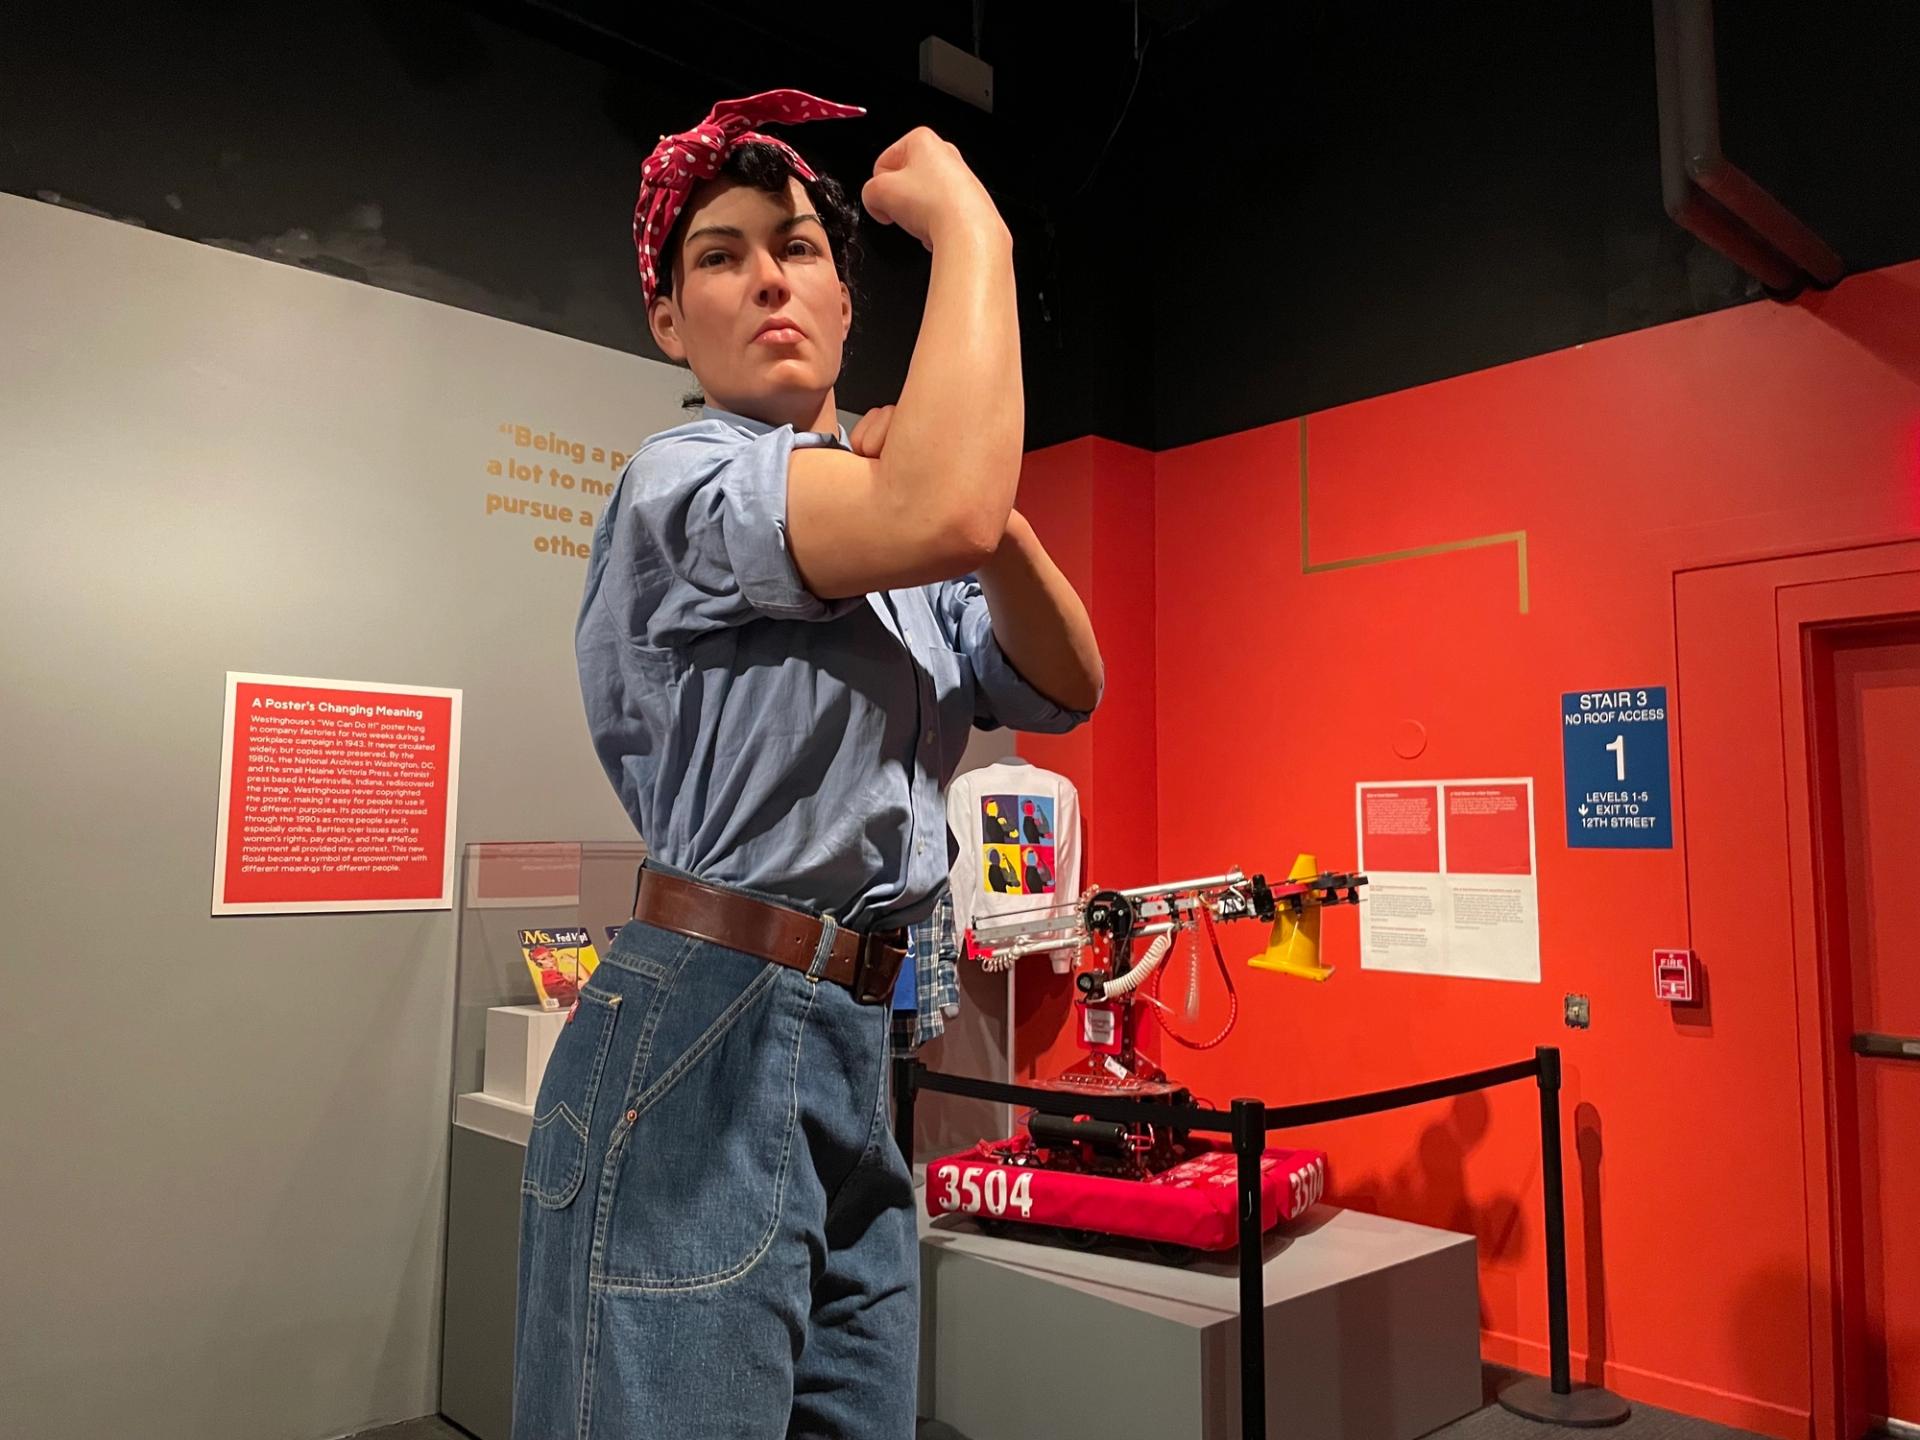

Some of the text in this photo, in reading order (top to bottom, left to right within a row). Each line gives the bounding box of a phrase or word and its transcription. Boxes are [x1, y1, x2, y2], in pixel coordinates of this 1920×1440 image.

[592, 448, 604, 463] a
[487, 460, 502, 476] a
[508, 458, 543, 484] lot
[550, 468, 576, 489] to
[486, 493, 593, 526] pursue a
[534, 536, 590, 558] othe
[1580, 691, 1647, 710] STAIR 3
[252, 697, 422, 720] A Poster's Changing Meaning
[250, 714, 315, 727] Westinghouse's
[336, 719, 352, 727] Can
[354, 720, 365, 728] Do
[381, 722, 405, 732] poster
[407, 723, 424, 733] hung
[1566, 709, 1664, 725] NO ROOF ACCESS
[249, 724, 257, 732] in
[259, 727, 297, 735] company
[300, 727, 335, 736] factories
[369, 731, 394, 739] weeks
[395, 732, 418, 742] during
[249, 734, 293, 745] workplace
[295, 736, 334, 747] campaign
[336, 738, 343, 746] in
[398, 742, 434, 750] circulated
[249, 744, 277, 754] widely,
[279, 745, 293, 753] but
[296, 746, 322, 756] copies
[346, 749, 388, 759] preserved.
[389, 750, 399, 759] By
[1606, 735, 1625, 780] 1
[278, 755, 292, 763] the
[294, 756, 327, 764] National
[330, 757, 363, 766] Archives
[374, 759, 419, 769] Washington,
[421, 761, 434, 769] DC,
[248, 764, 263, 772] and
[282, 765, 302, 773] small
[304, 766, 334, 774] Helaine
[336, 767, 366, 775] Victoria
[271, 775, 296, 783] based
[386, 779, 433, 787] rediscovered
[293, 785, 350, 795] Westinghouse
[262, 794, 291, 804] poster,
[293, 795, 323, 804] making
[366, 797, 392, 806] people
[1586, 792, 1648, 802] LEVELS 1-5
[260, 804, 296, 812] different
[351, 806, 389, 815] popularity
[1596, 804, 1639, 815] EXIT TO
[244, 814, 277, 823] through
[355, 816, 382, 824] people
[1582, 817, 1656, 828] 12TH STREET
[243, 824, 285, 833] especially
[283, 834, 307, 843] rights,
[301, 844, 336, 853] provided
[311, 854, 340, 863] symbol
[352, 854, 408, 863] empowerment
[241, 864, 278, 872] different
[281, 864, 320, 873] meanings
[336, 863, 370, 871] different
[372, 863, 401, 872] people.
[523, 930, 555, 944] Ms.
[1660, 958, 1683, 968] FIRE
[938, 1165, 1033, 1218] 3504
